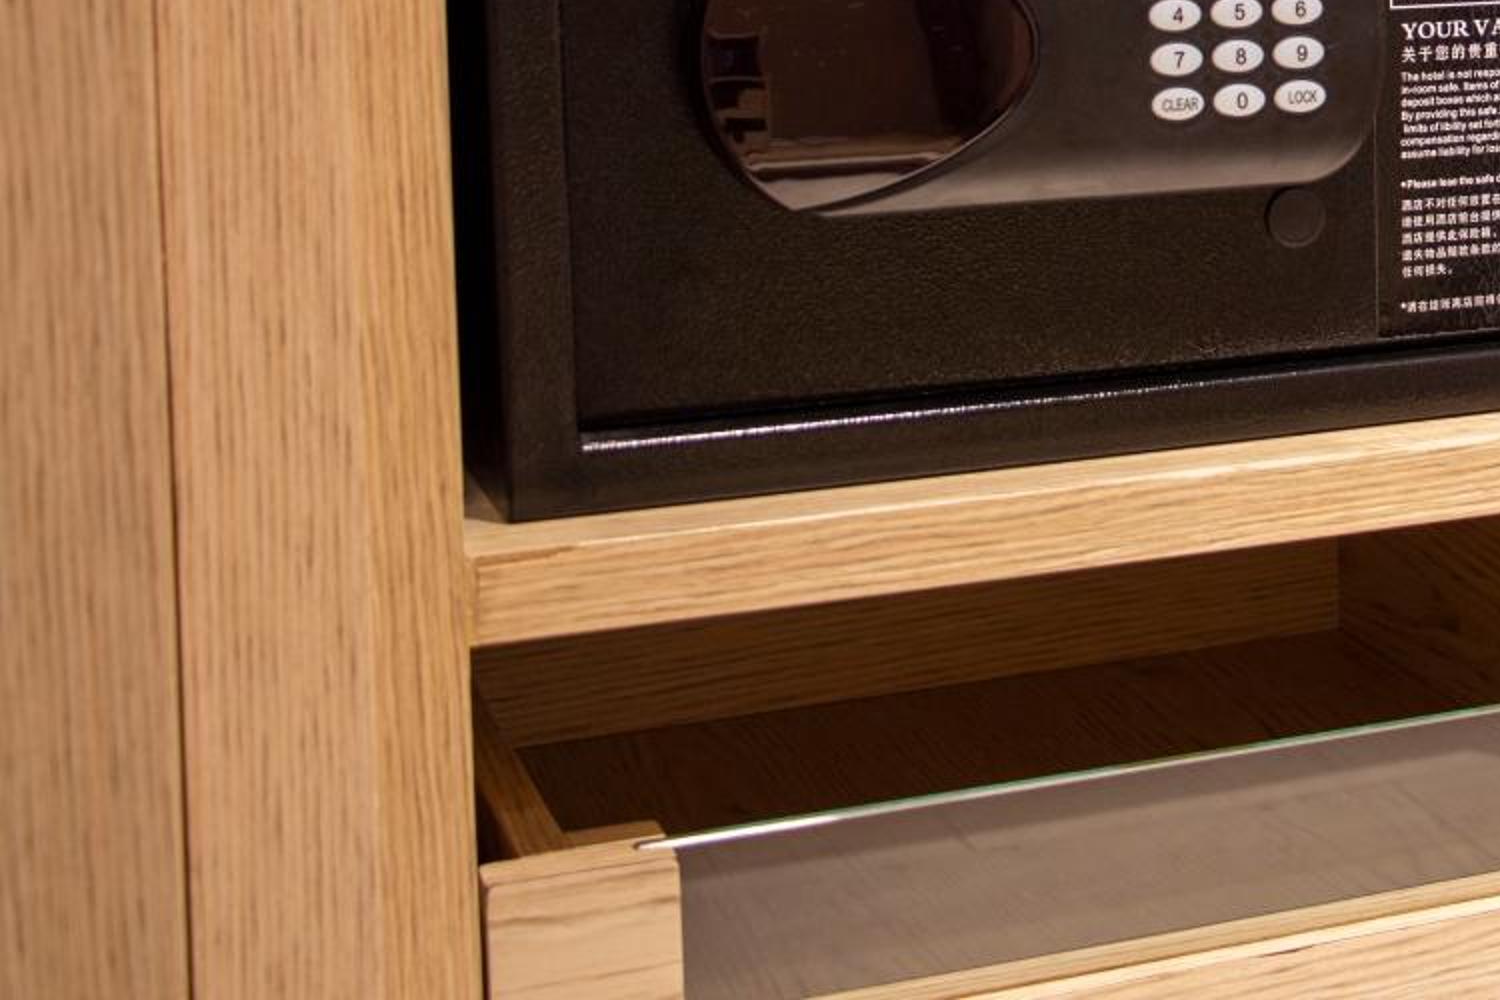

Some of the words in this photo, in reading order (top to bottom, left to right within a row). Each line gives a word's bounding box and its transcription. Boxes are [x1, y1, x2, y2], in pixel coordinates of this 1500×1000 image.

[1173, 7, 1183, 24] 4
[1235, 3, 1246, 21] 5
[1295, 0, 1306, 18] 6
[1400, 19, 1470, 40] YOUR
[1174, 51, 1185, 69] 7
[1236, 47, 1247, 65] 8
[1297, 44, 1308, 62] 9
[1401, 72, 1419, 82] The
[1421, 71, 1445, 80] hotel
[1456, 69, 1472, 78] not
[1489, 80, 1499, 89] of
[1161, 97, 1199, 113] CLEAR
[1237, 92, 1249, 109] 0
[1288, 90, 1317, 105] LOCK
[1401, 97, 1434, 109] deposit
[1435, 95, 1464, 105] boxes
[1465, 93, 1492, 103] which
[1401, 111, 1414, 122] By
[1415, 108, 1458, 121] providing
[1459, 107, 1476, 117] this
[1403, 123, 1428, 133] limits
[1429, 122, 1439, 132] of
[1467, 120, 1482, 129] set
[1400, 134, 1464, 148] compensation
[1400, 150, 1437, 159] assume
[1471, 145, 1485, 154] for
[1459, 176, 1474, 185] the
[1475, 174, 1495, 184] safe
